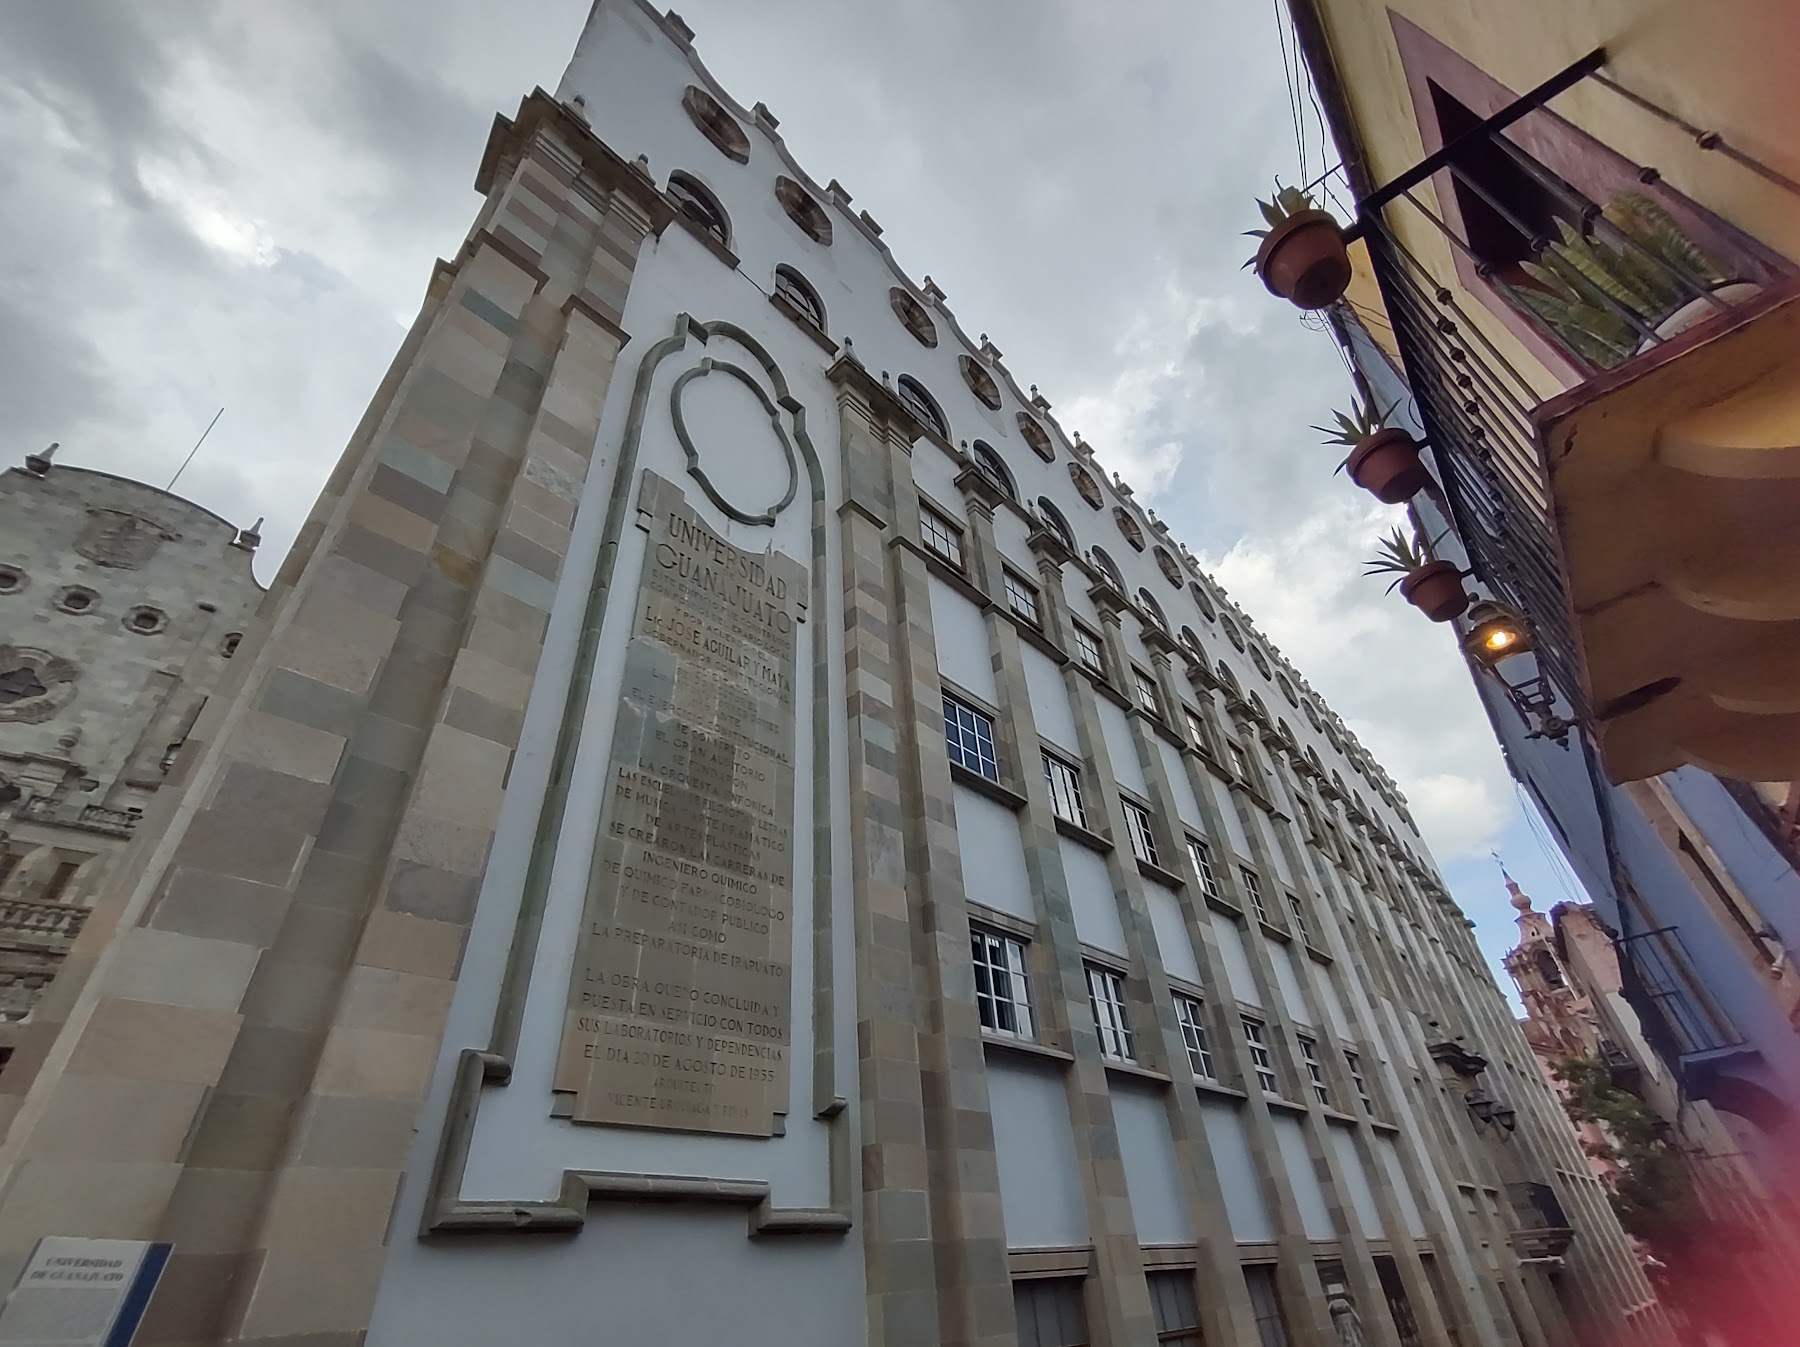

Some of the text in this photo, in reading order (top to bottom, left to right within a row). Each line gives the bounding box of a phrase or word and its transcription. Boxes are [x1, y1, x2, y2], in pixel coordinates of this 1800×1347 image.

[667, 512, 786, 602] UNIVERSIDAD
[654, 539, 790, 637] GUANAJUATO
[667, 616, 700, 646] JOSE
[703, 634, 750, 671] AGUILAR
[753, 660, 759, 676] Y
[762, 664, 789, 691] MAYA
[683, 611, 702, 627] POR
[706, 623, 747, 651] ACUERDO
[643, 625, 789, 703] GOBERNADOR CONSTITUCIONAL
[632, 687, 787, 762] EL EJERCICIO CONSTITUCIONAL
[655, 730, 669, 743] EL
[673, 737, 705, 758] GRAN
[676, 722, 688, 734] SE
[639, 757, 654, 771] LA
[659, 765, 718, 796] ORQUESTA
[673, 753, 684, 766] SE
[615, 784, 631, 799] DE
[635, 791, 675, 814] MUSICA
[722, 822, 783, 853] DRAMATICO
[618, 767, 637, 782] LAS
[640, 775, 684, 800] ESCUEL
[759, 819, 786, 837] LETRAS
[610, 820, 784, 886] SE CREARON LAS CARRERAS DE
[645, 813, 759, 861] DE ARTES PLASTICAS
[603, 859, 619, 874] DE
[623, 865, 677, 891] QUIMICO
[642, 850, 756, 895] INGENIERO QUIMICO
[620, 885, 767, 936] Y DE CONTADOR PUBLICO
[668, 919, 726, 944] ASI COMO
[592, 922, 783, 979] LA PREPARATORIA DE IRAPUATO
[582, 991, 782, 1040] PUESTA EN SERVICIO CON TODOS
[585, 966, 779, 1018] LA OBRA QUEDO CONCLUIDA Y
[577, 1015, 781, 1062] SUS LABORATORIOS Y DEPENDENCIAS
[583, 1043, 602, 1060] EL
[606, 1046, 629, 1063] DIA
[652, 1053, 670, 1069] DE
[674, 1057, 726, 1077] AGOSTO
[730, 1065, 745, 1080] DE
[749, 1068, 773, 1084] 1955
[30, 1270, 124, 1281] DE GUANAJUATO
[45, 1256, 123, 1268] UNIVERSIDAD
